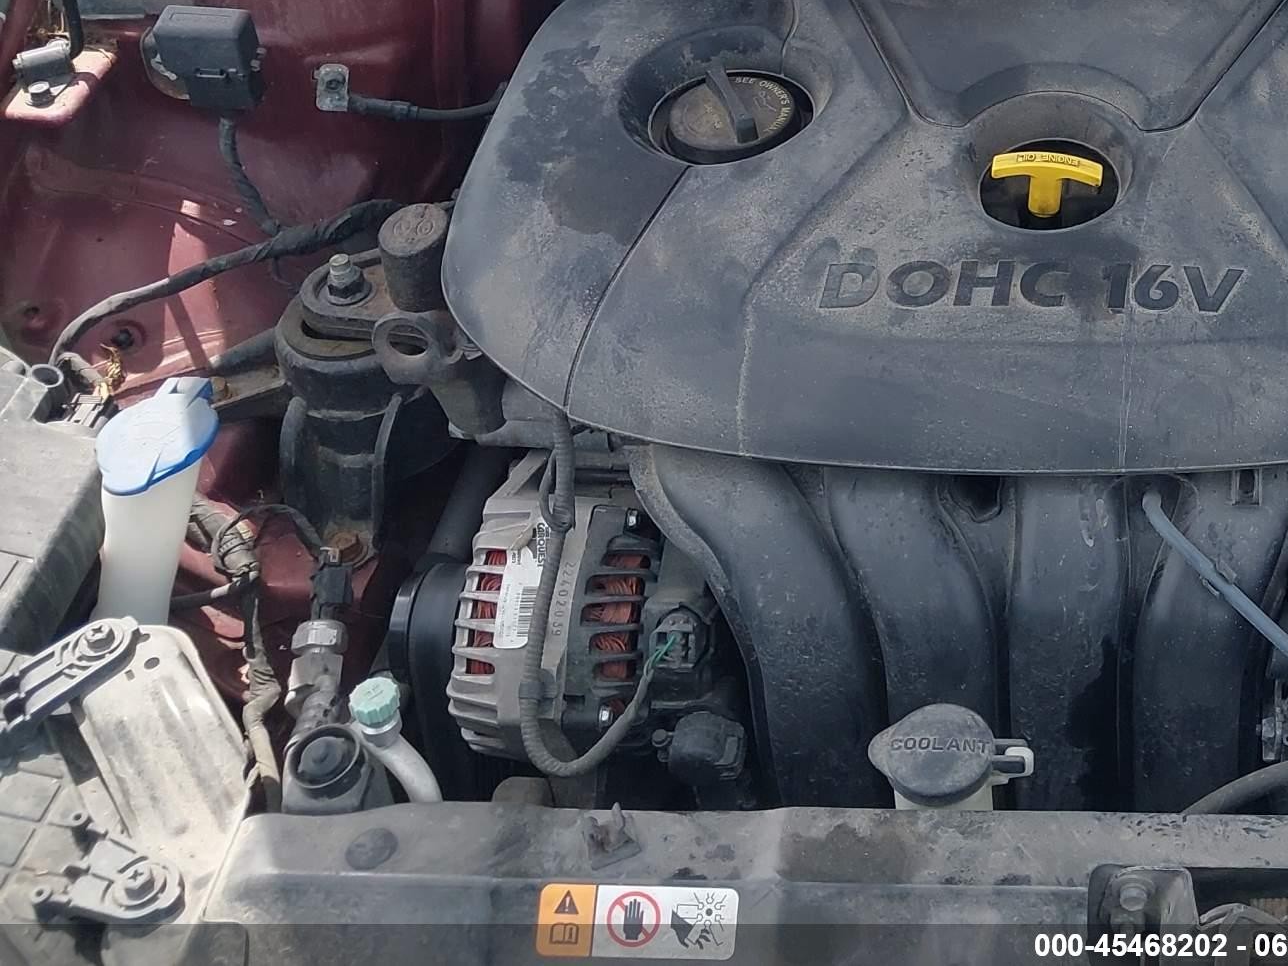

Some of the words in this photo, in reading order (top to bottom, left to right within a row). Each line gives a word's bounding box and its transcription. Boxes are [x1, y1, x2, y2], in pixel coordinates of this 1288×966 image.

[1016, 153, 1037, 162] OIL
[1040, 154, 1081, 167] ENGINE
[817, 259, 1071, 309] DOHC
[1104, 262, 1245, 314] 16V
[889, 736, 990, 754] COOLANT
